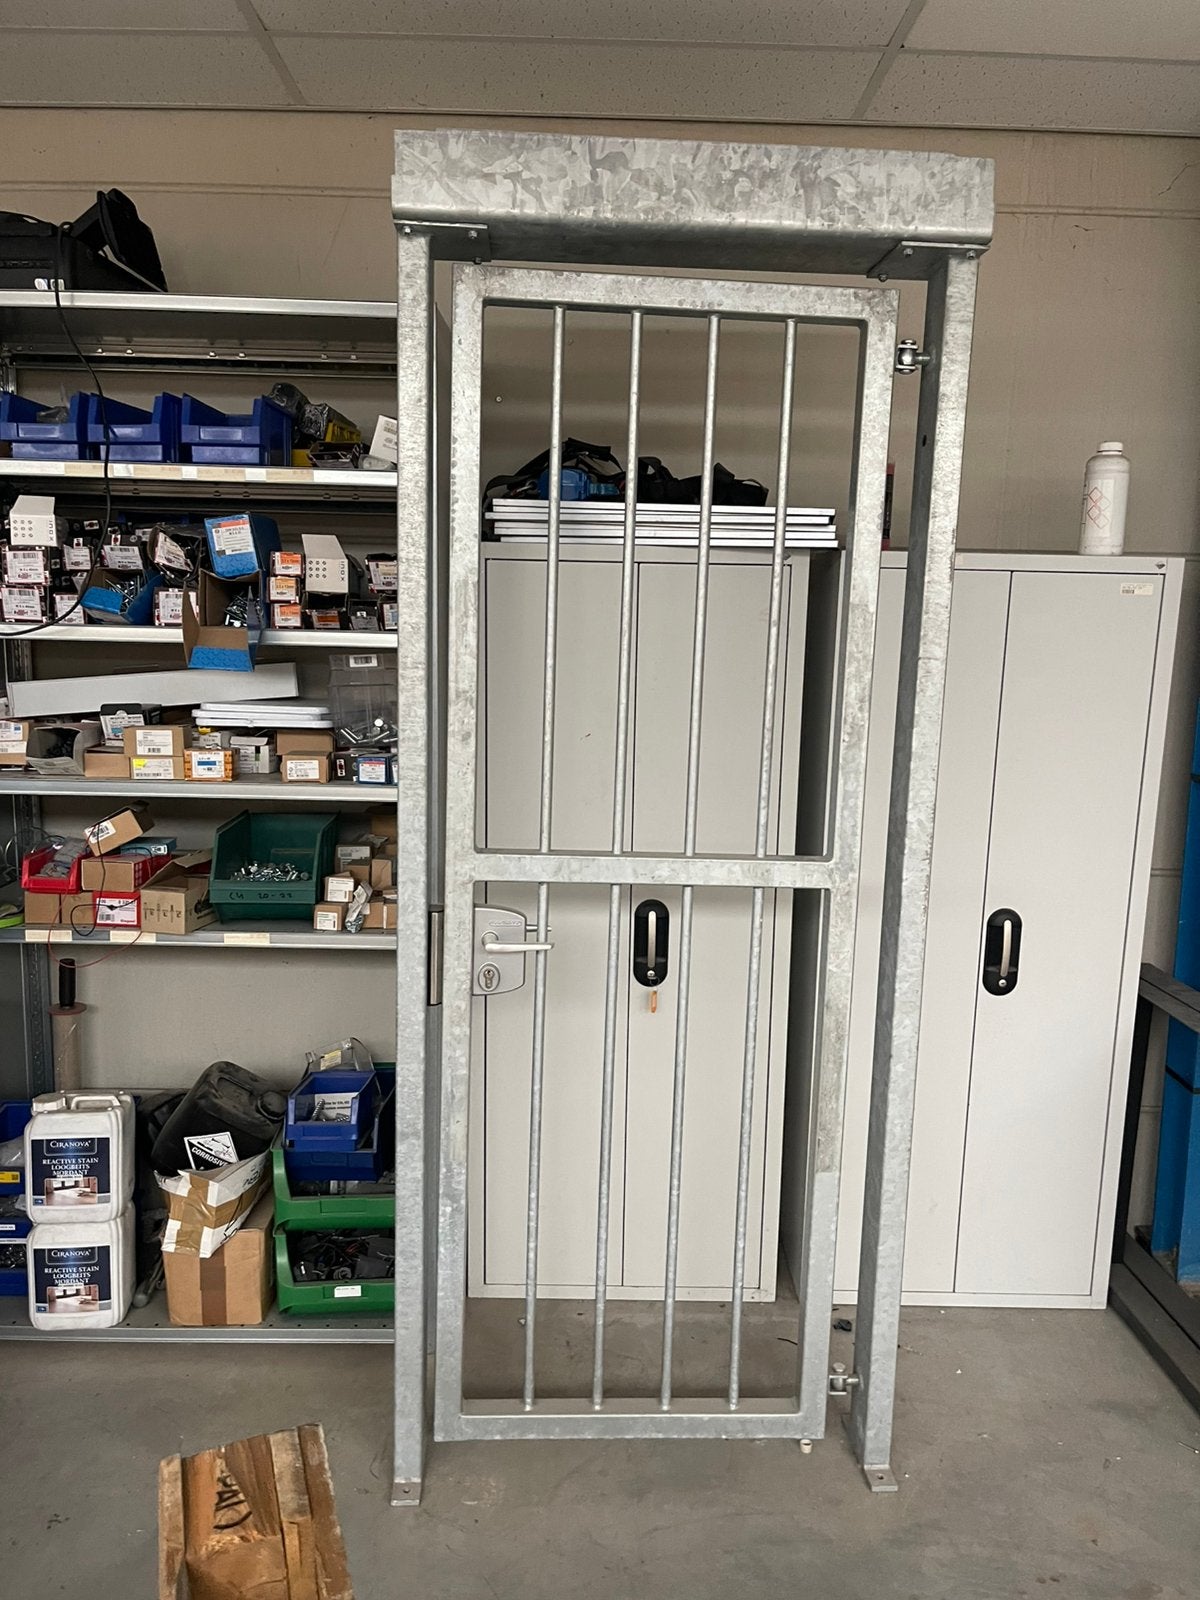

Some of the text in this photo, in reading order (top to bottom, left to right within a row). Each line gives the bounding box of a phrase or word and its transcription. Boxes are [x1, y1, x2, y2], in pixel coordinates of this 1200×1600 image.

[50, 1140, 90, 1148] CIRANOVA
[51, 1250, 90, 1258] CIRANOVA
[54, 1277, 89, 1285] MORDANT
